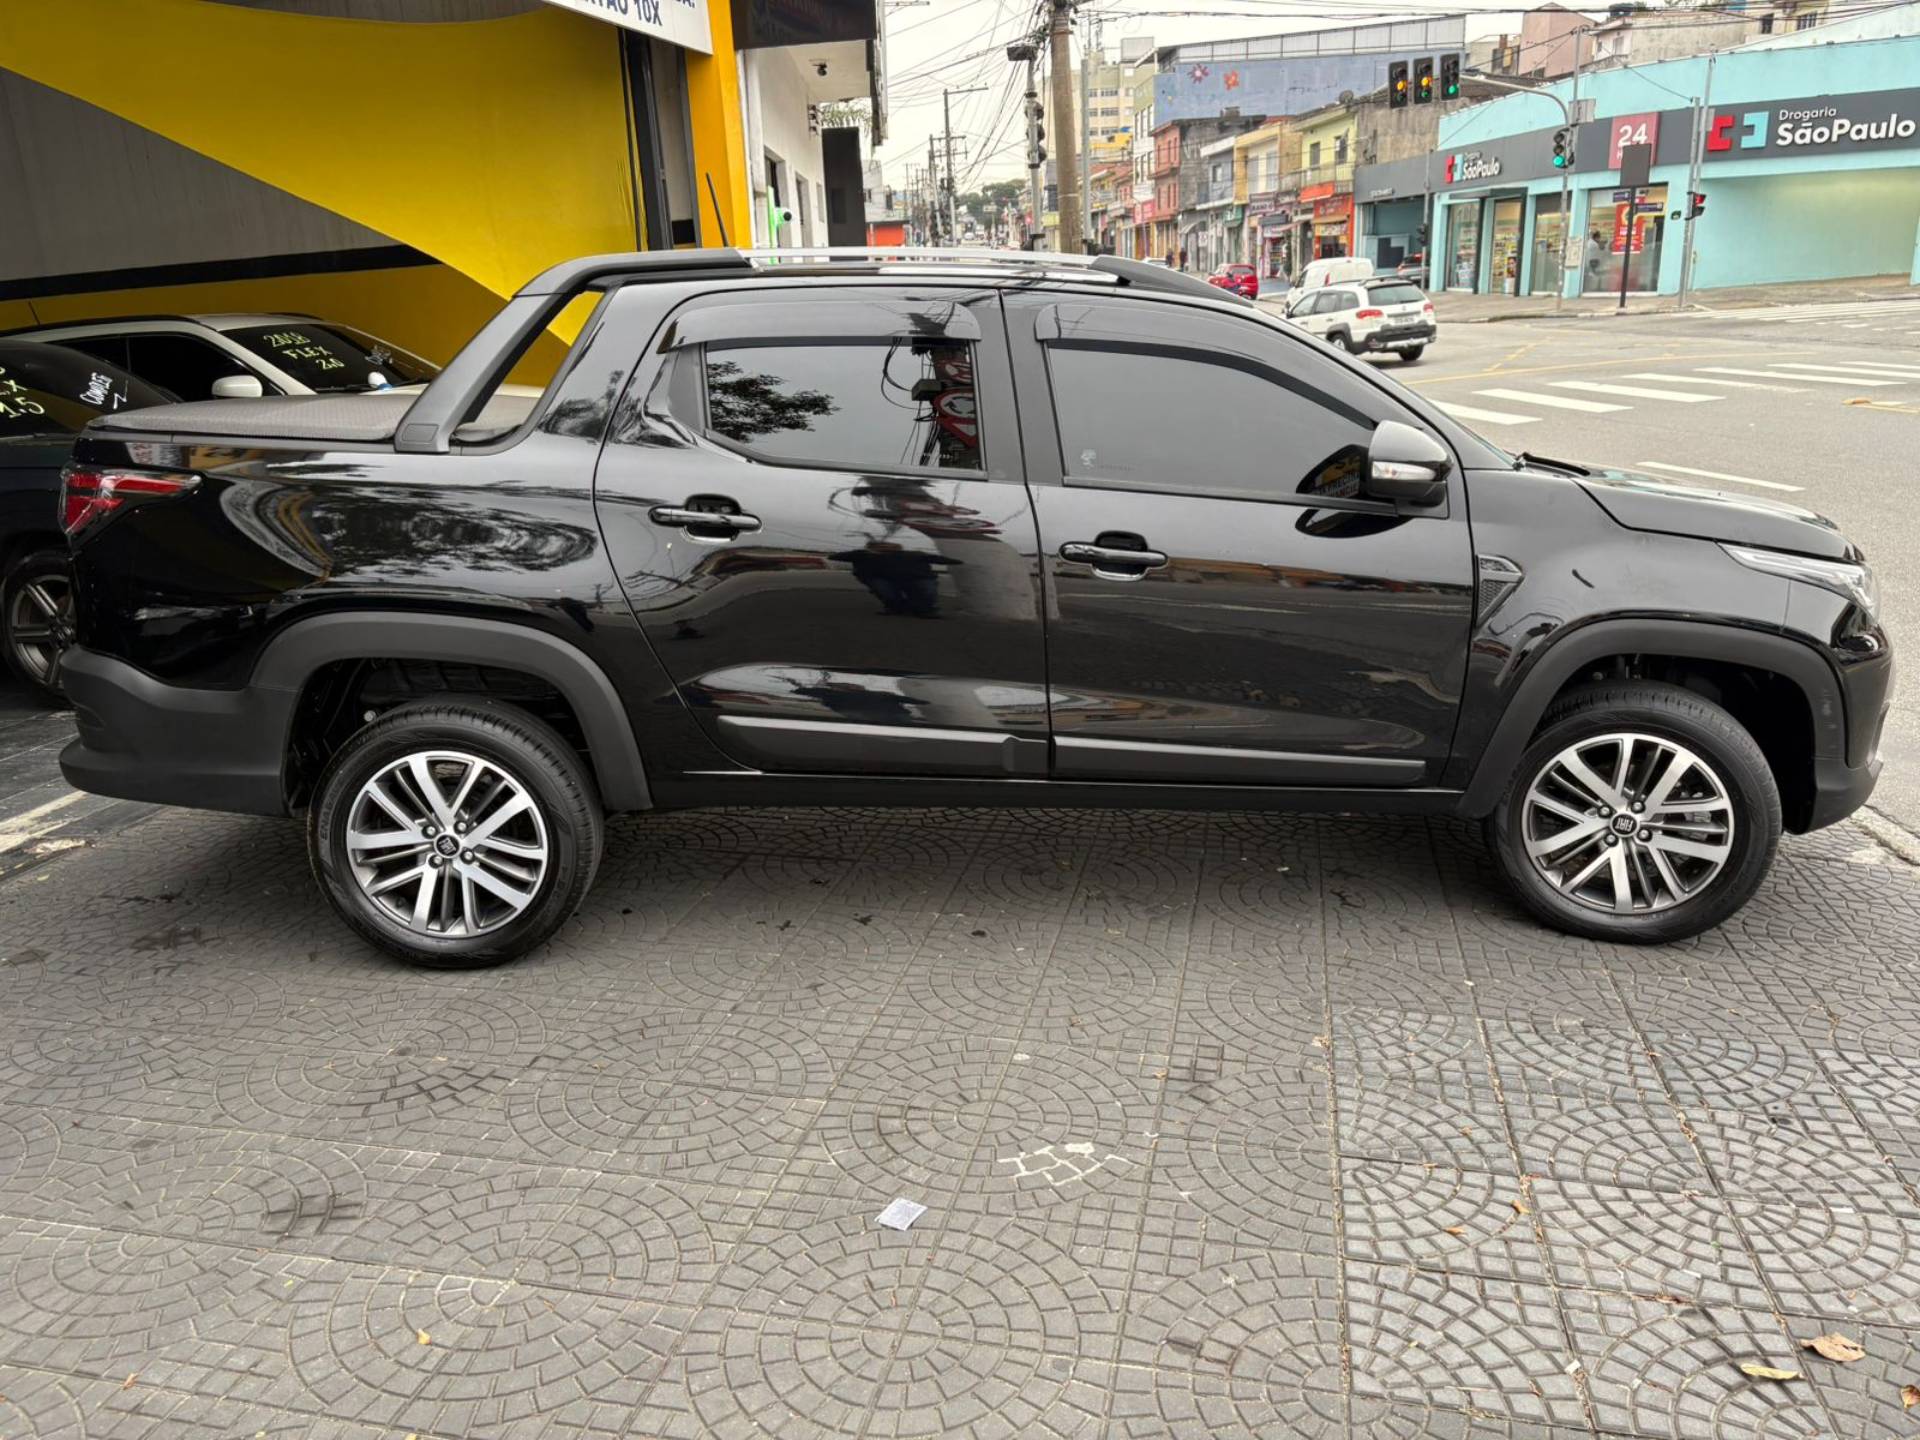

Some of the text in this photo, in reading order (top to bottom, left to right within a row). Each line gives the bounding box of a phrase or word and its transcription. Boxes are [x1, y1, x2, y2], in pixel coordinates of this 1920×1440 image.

[634, 0, 663, 26] 10X
[1779, 106, 1837, 121] Drogaria
[1617, 122, 1648, 148] 24
[1776, 114, 1916, 146] SãoPaulo
[282, 345, 333, 360] FLEX
